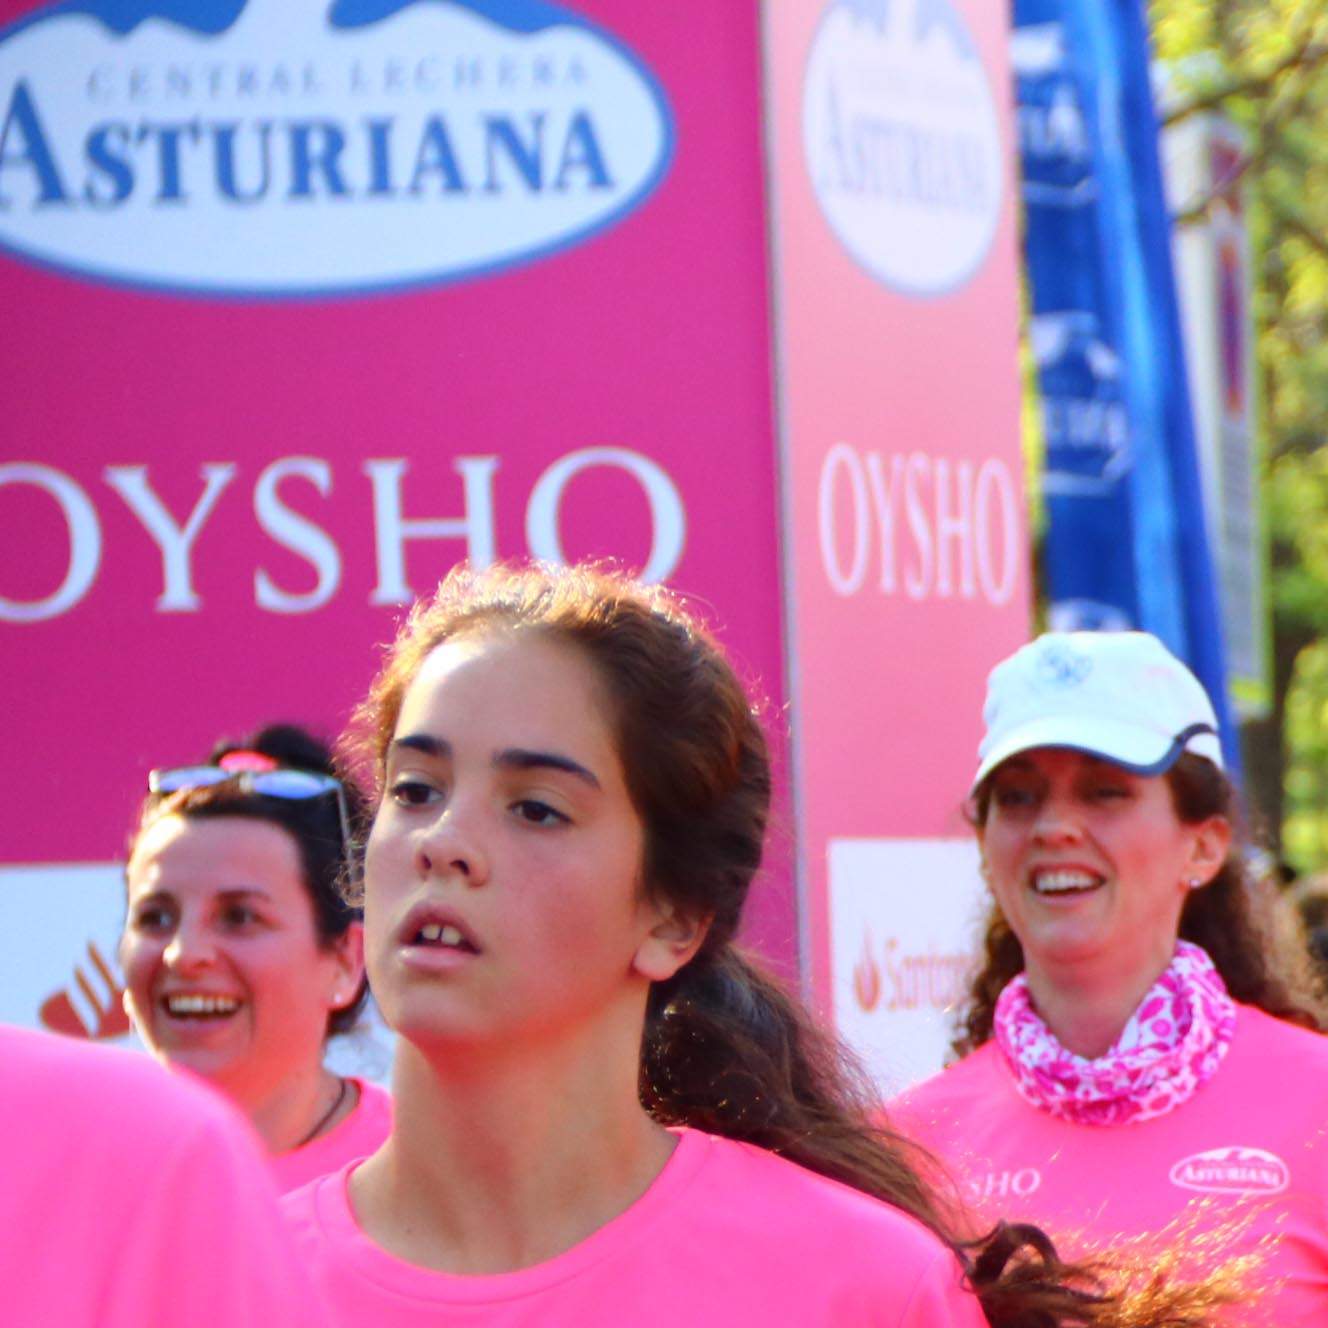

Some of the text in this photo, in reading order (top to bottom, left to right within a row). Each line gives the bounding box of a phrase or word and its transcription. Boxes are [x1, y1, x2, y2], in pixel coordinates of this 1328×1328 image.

[0, 76, 617, 210] ASTURIANA
[88, 52, 590, 100] CENTRAL LECHERA
[0, 446, 687, 624] OYSHO
[818, 442, 1021, 606] OYSHO
[1182, 1164, 1279, 1186] ASTURIANA
